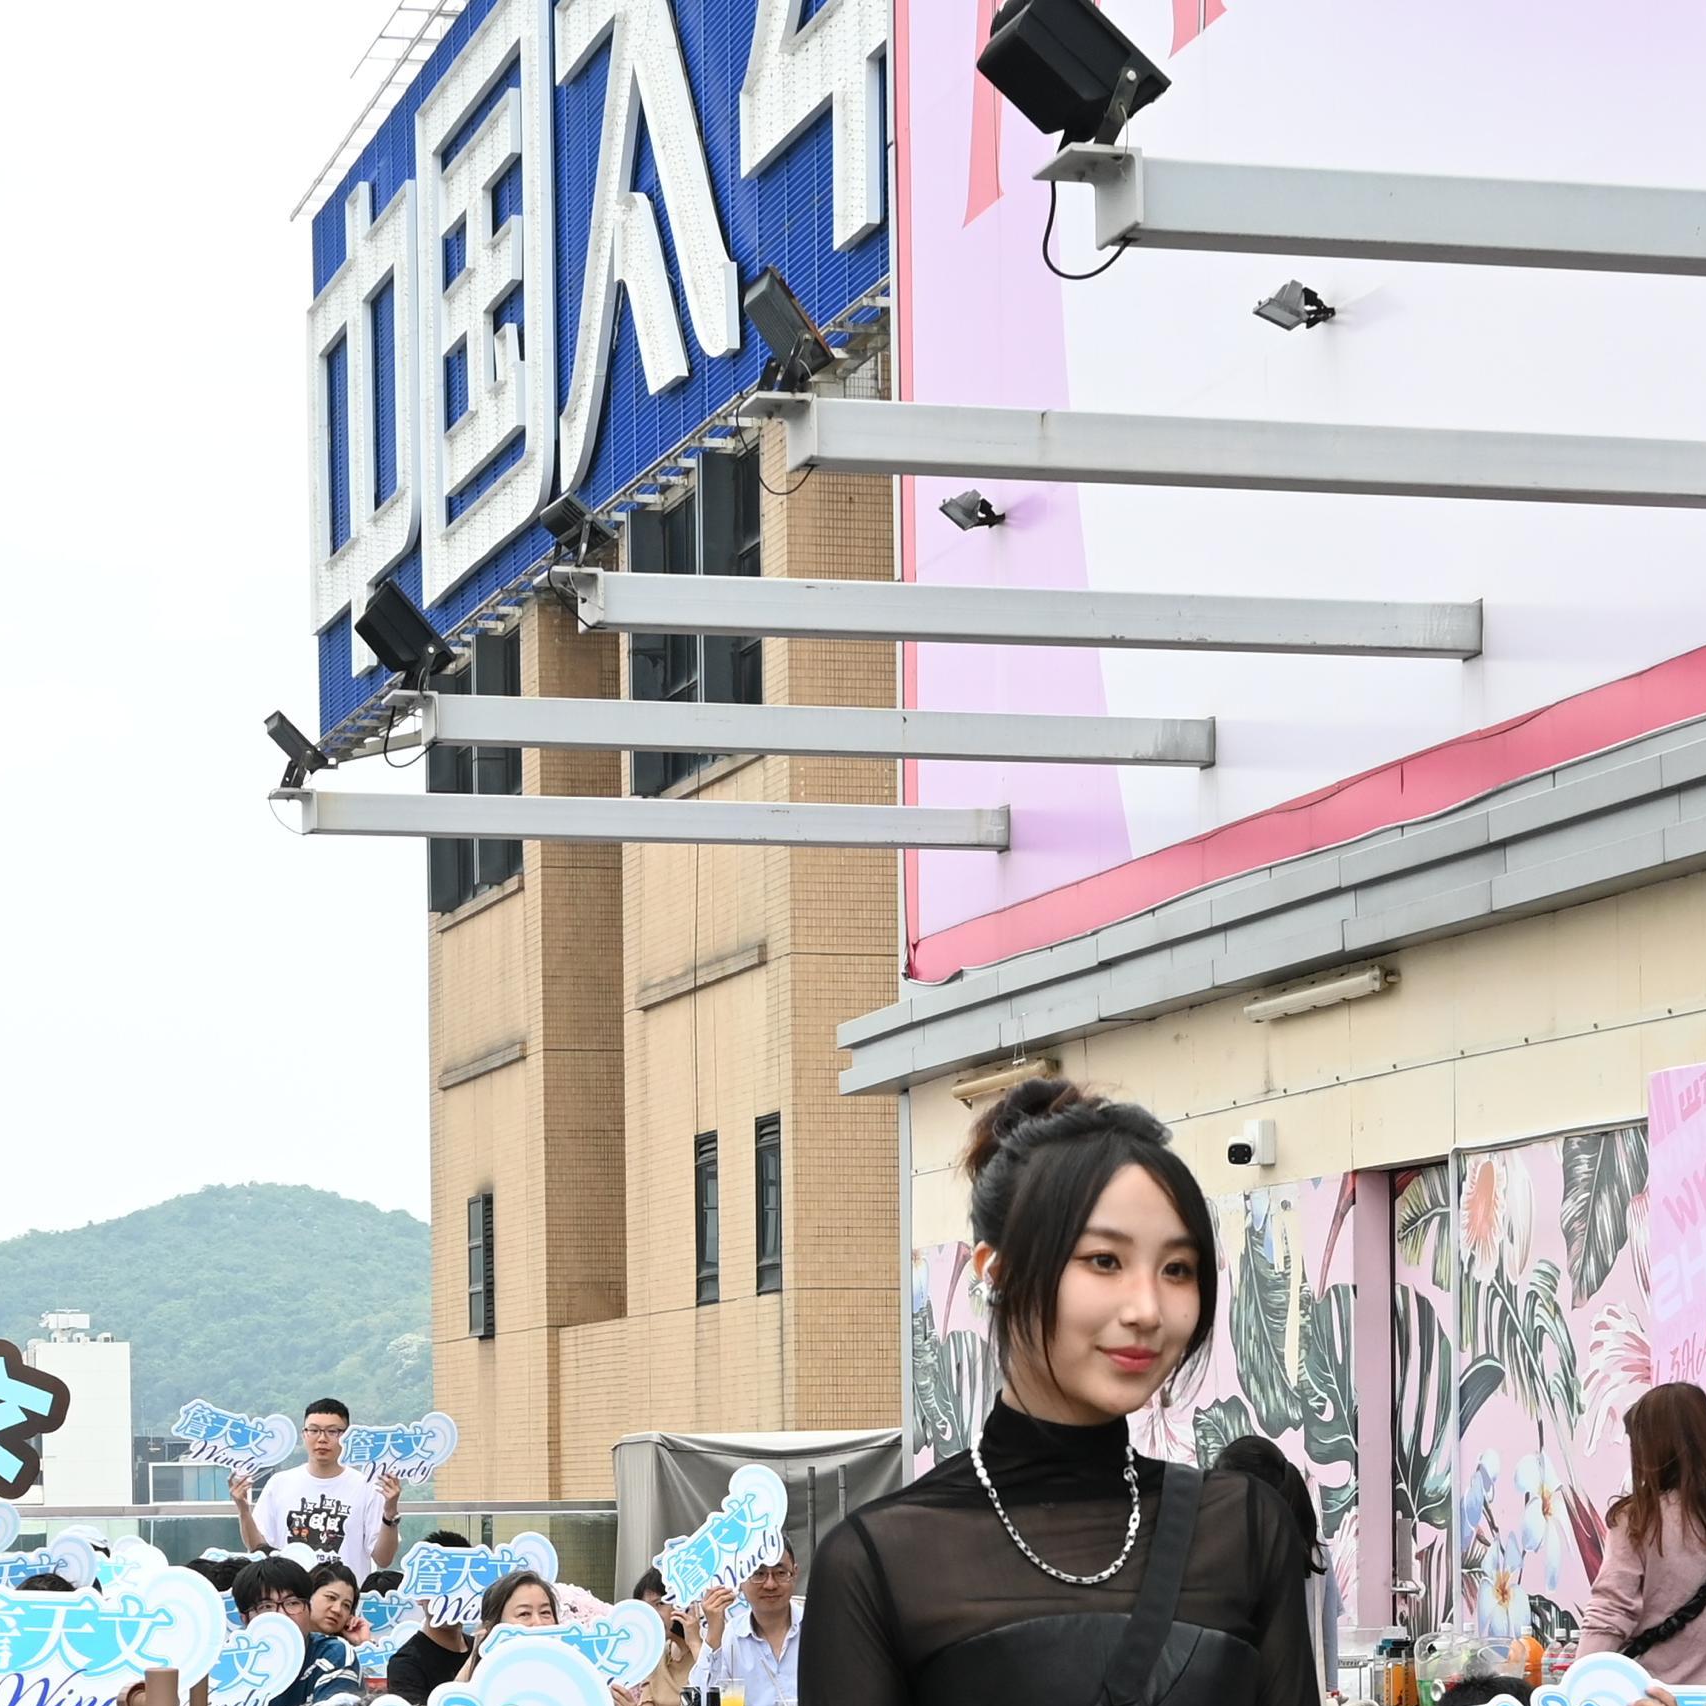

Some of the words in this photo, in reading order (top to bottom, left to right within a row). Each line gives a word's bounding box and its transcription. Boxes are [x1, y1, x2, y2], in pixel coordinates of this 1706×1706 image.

[180, 1402, 274, 1456] 詹天文
[343, 1427, 435, 1463] 詹天文
[192, 1440, 264, 1476] Windy
[667, 1492, 769, 1605] 詹天文
